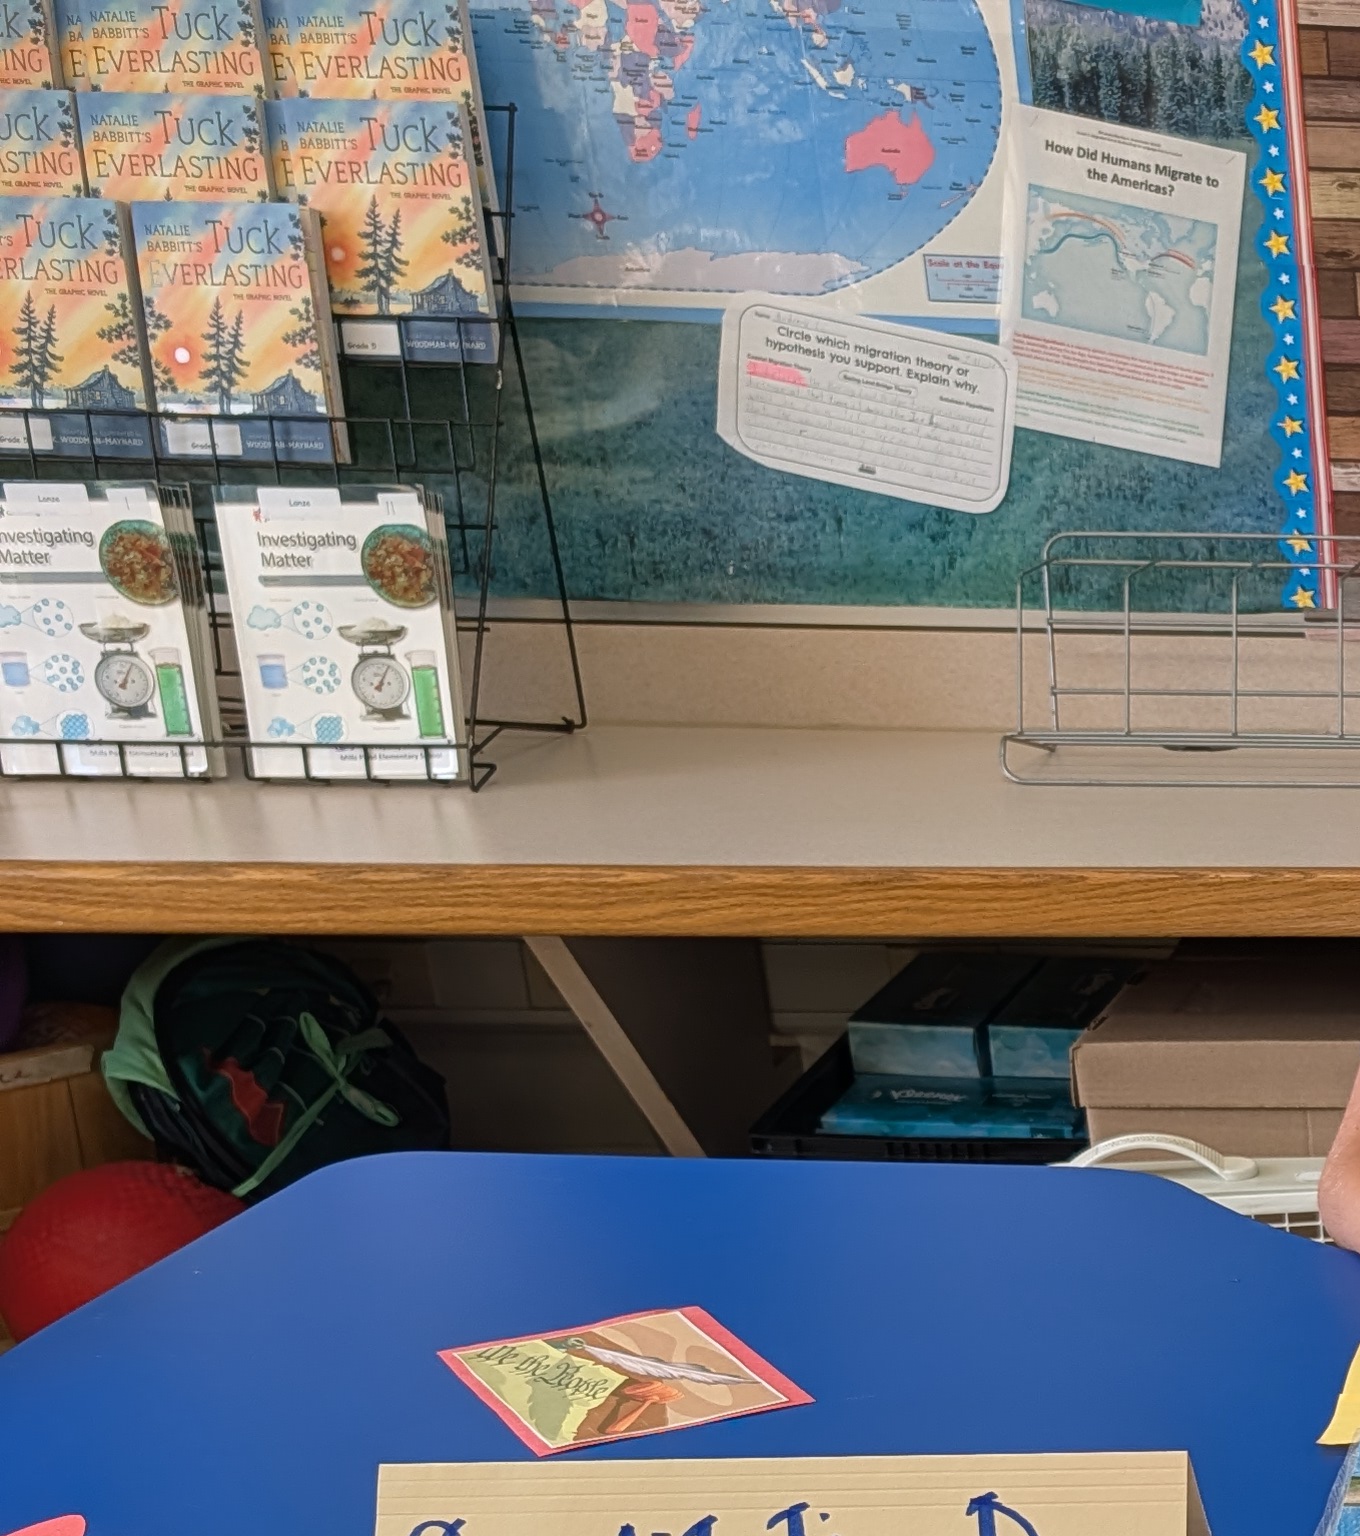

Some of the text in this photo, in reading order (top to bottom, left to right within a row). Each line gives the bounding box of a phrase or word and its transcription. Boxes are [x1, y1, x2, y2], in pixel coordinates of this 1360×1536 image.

[297, 121, 345, 134] NATALIE
[300, 138, 358, 150] BABBITT'S
[300, 157, 462, 188] EVERLASTING
[1045, 139, 1074, 156] How
[1077, 146, 1097, 161] Did
[1101, 152, 1151, 173] Humans
[1155, 163, 1203, 185] Migrate
[1206, 176, 1219, 188] to
[1087, 169, 1175, 196] the Americas?
[144, 224, 191, 236] NATALIE
[146, 240, 202, 252] BABBITT'S
[150, 260, 303, 288] EVERLASTING
[765, 336, 979, 394] hypothesis you support. Explain why.
[777, 326, 970, 377] Circle which migration theory or
[257, 532, 356, 550] Investigating
[261, 553, 313, 568] Matter
[469, 1345, 609, 1400] We the People
